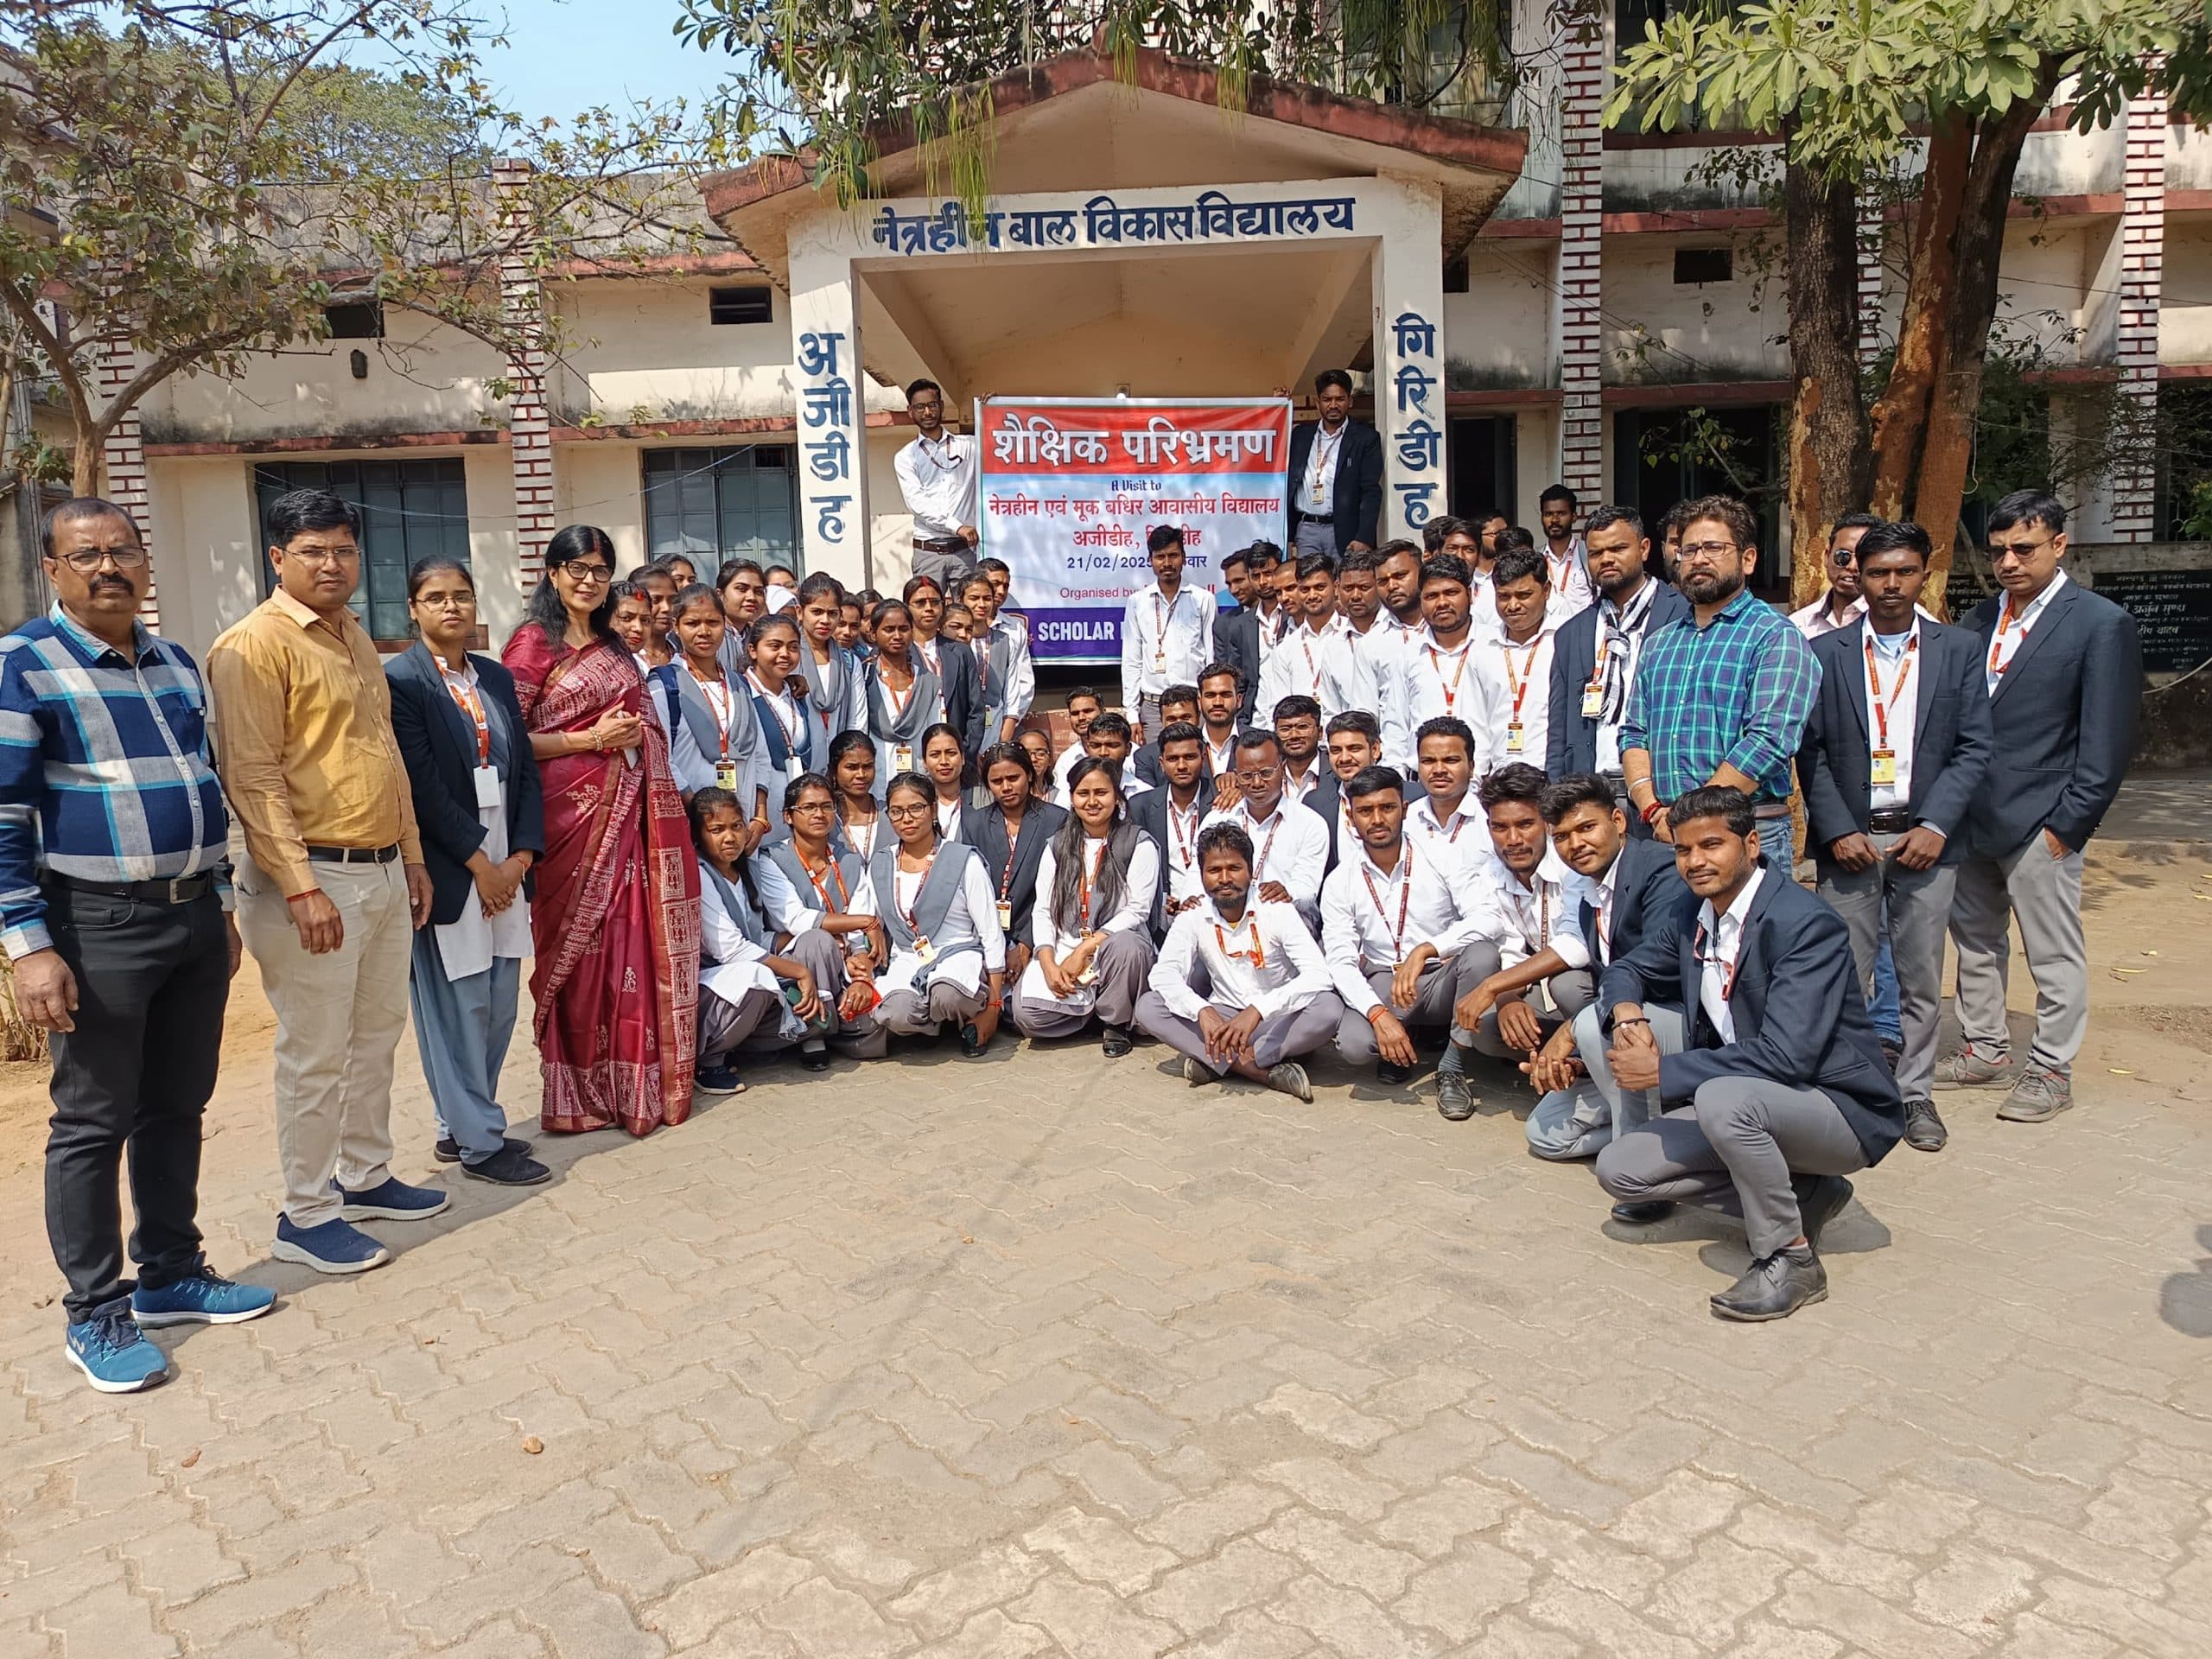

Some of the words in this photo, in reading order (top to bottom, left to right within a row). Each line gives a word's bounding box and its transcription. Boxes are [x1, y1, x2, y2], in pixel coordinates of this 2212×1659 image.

[1009, 210, 1077, 246] बाल
[1083, 195, 1194, 245] विकास
[1196, 190, 1356, 238] विद्यालय
[992, 412, 1110, 467] शैक्षिक
[1122, 416, 1277, 465] परिभ्रमण
[1122, 480, 1148, 492] Visit
[1150, 480, 1161, 491] to
[988, 493, 1039, 516] नेत्रहीन
[1044, 494, 1067, 518] एवं
[1072, 499, 1100, 522] मूक
[1105, 494, 1144, 515] बधिर
[1148, 493, 1217, 515] आवासीय
[1221, 493, 1281, 514] विद्यालय
[1073, 524, 1140, 549] अजीडीह,
[1059, 587, 1119, 601] Organised
[1038, 621, 1115, 641] SCHOLAR
